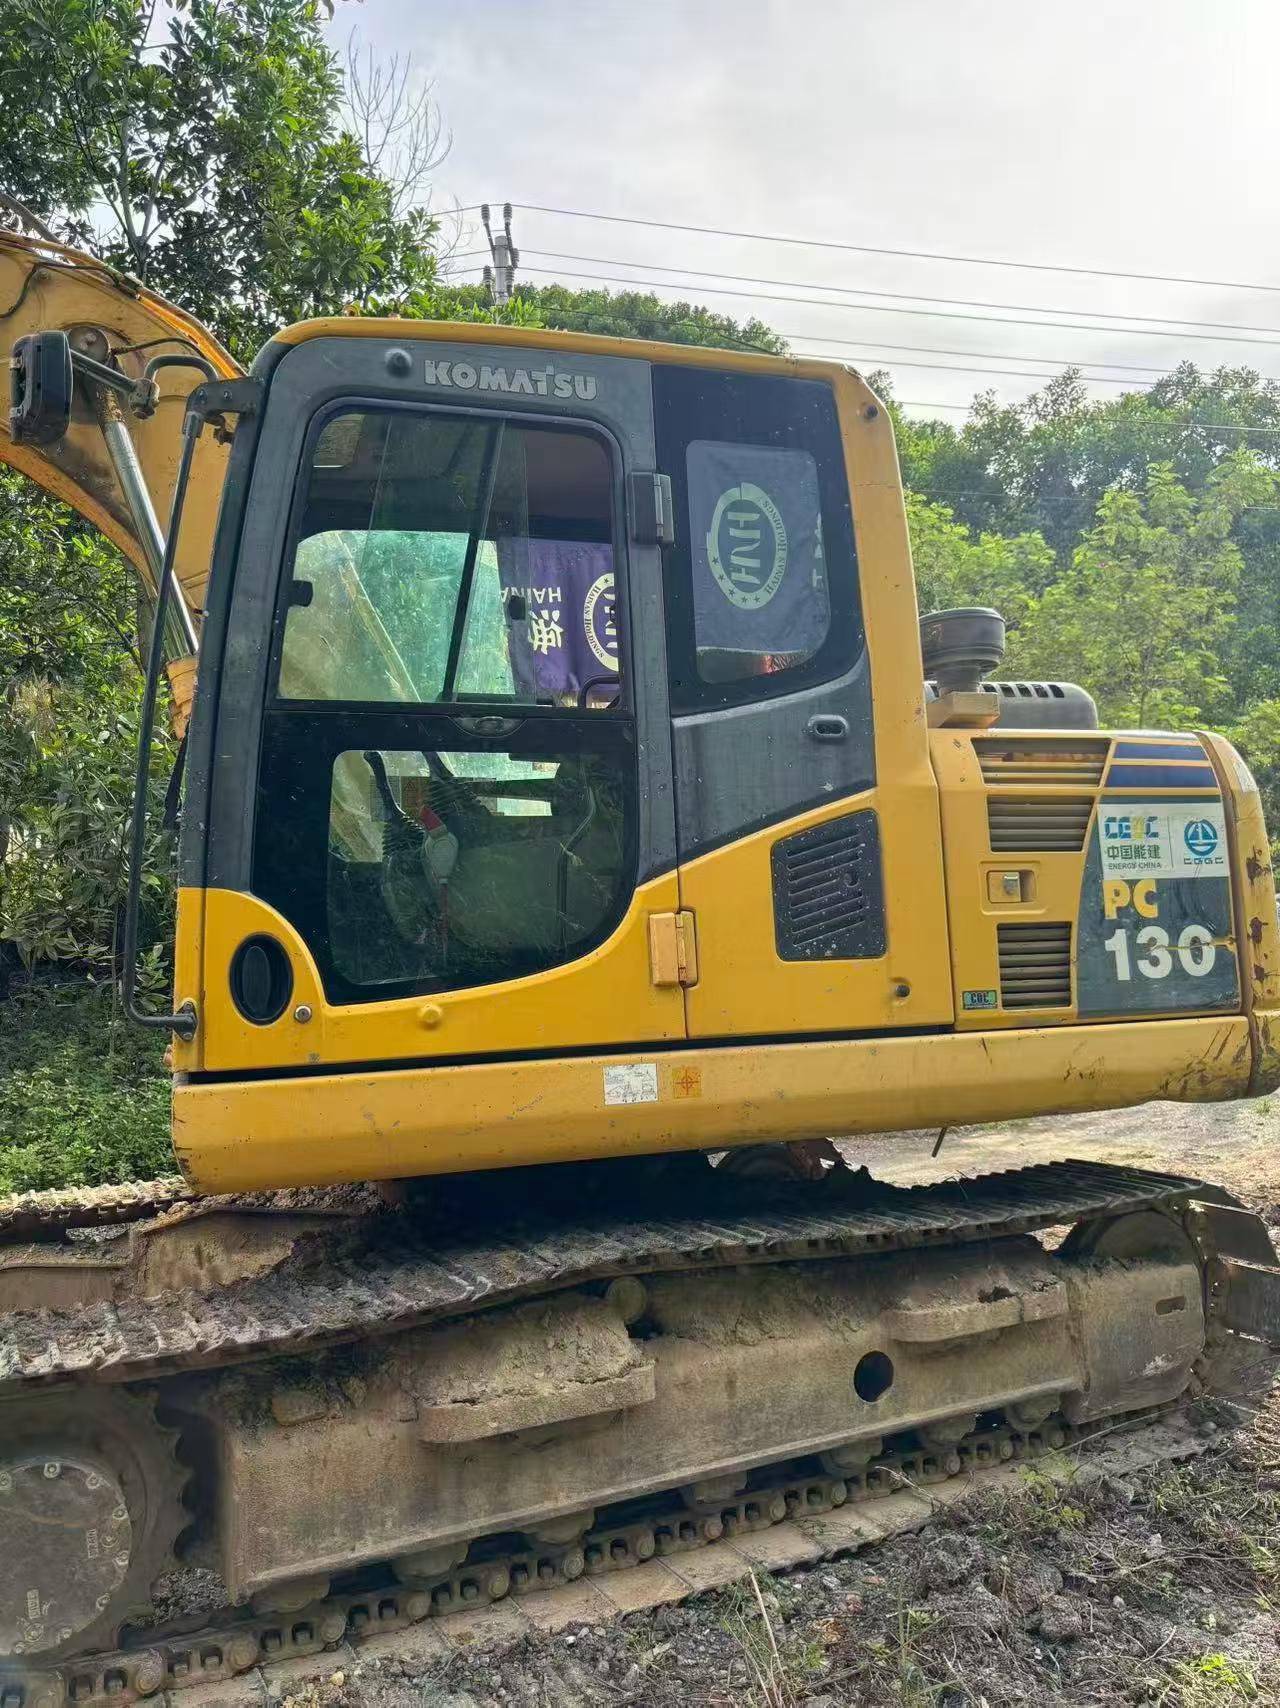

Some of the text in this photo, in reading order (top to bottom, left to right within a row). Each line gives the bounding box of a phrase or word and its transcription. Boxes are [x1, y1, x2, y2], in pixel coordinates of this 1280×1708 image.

[424, 359, 597, 400] KOMATSU
[762, 500, 787, 595] HAINAN HOLDINGS
[585, 584, 604, 658] HAINAN HOLDINGS
[1107, 844, 1161, 861] 中国能建
[1108, 861, 1162, 870] ENERGY CHINA
[1103, 879, 1159, 920] PC
[1104, 924, 1216, 981] 130
